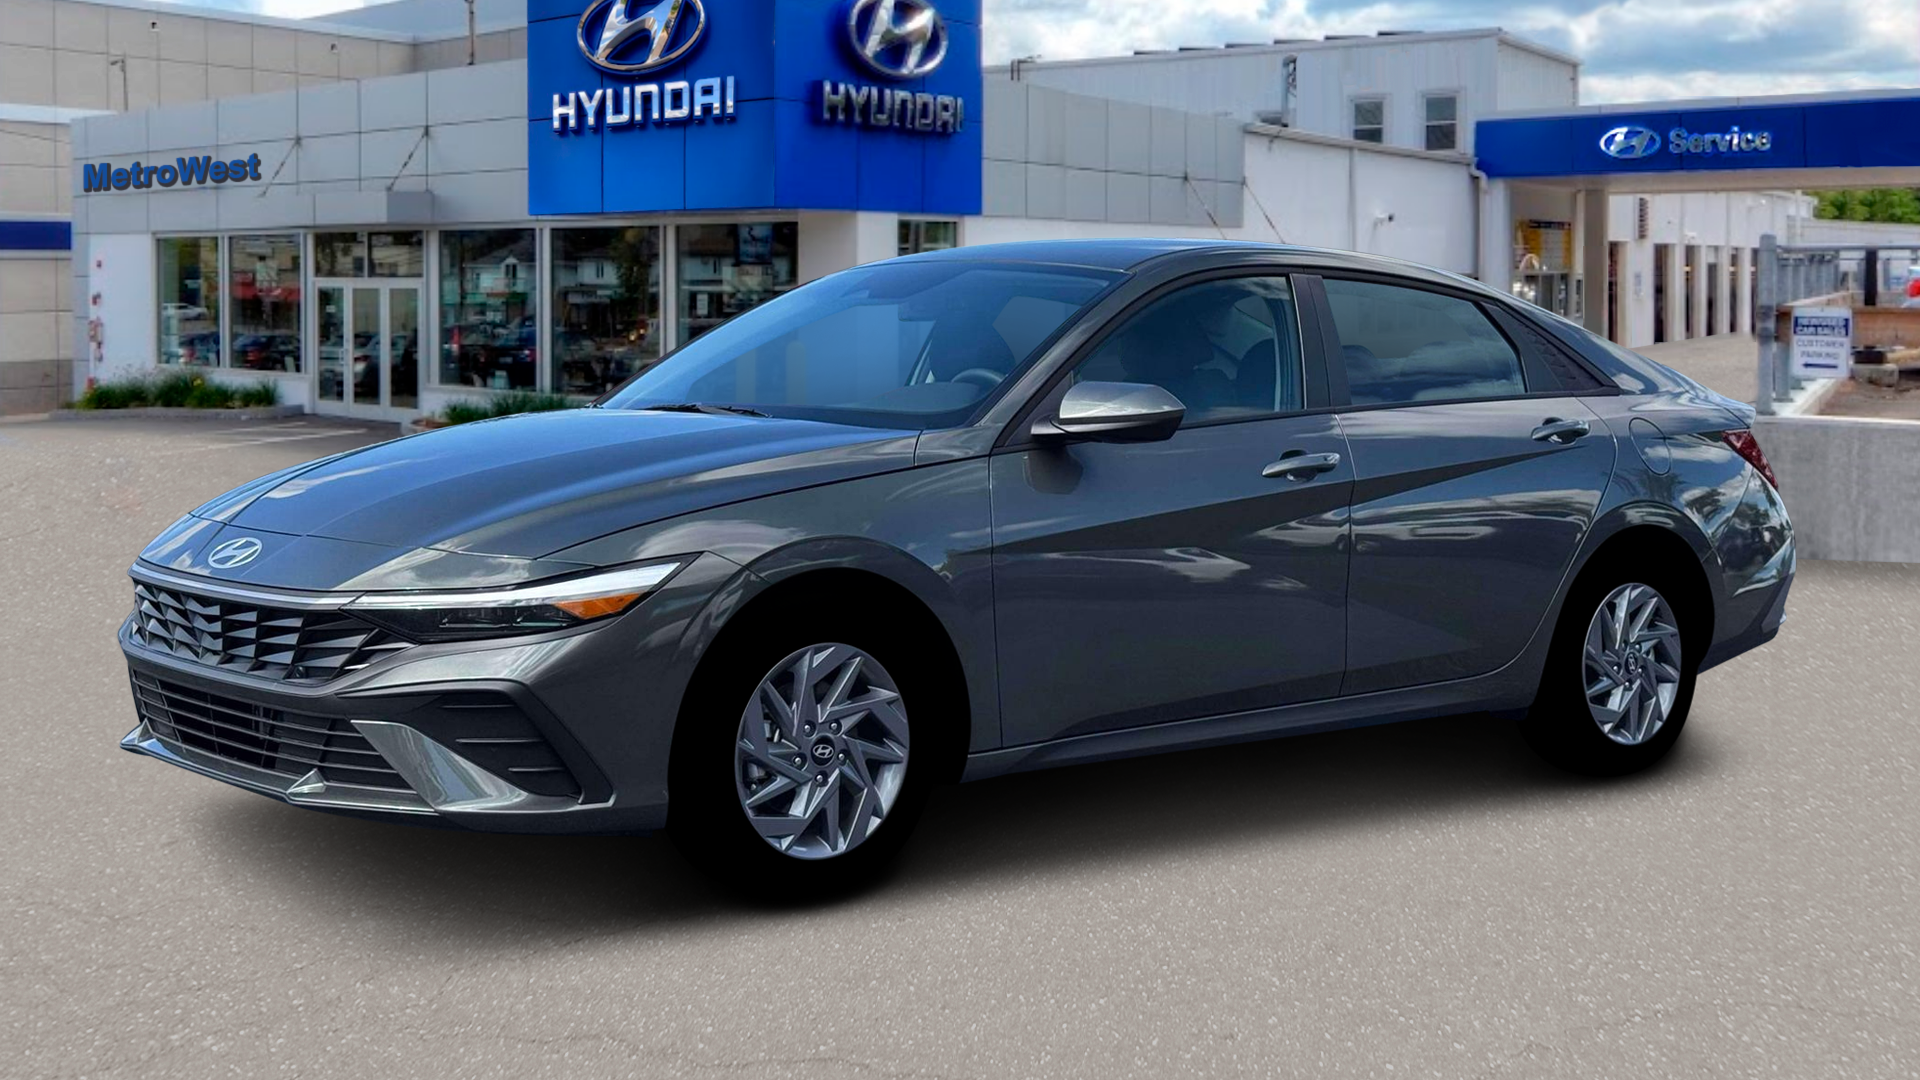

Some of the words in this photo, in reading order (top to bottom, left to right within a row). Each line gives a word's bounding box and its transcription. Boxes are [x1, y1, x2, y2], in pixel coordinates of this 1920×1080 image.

[552, 75, 736, 132] HYUNDAI
[822, 80, 964, 133] HYUNDAI
[1669, 125, 1772, 154] Service
[83, 153, 262, 192] MetroWest
[1796, 339, 1845, 349] CUSTOMER
[1800, 350, 1840, 360] PARKING
